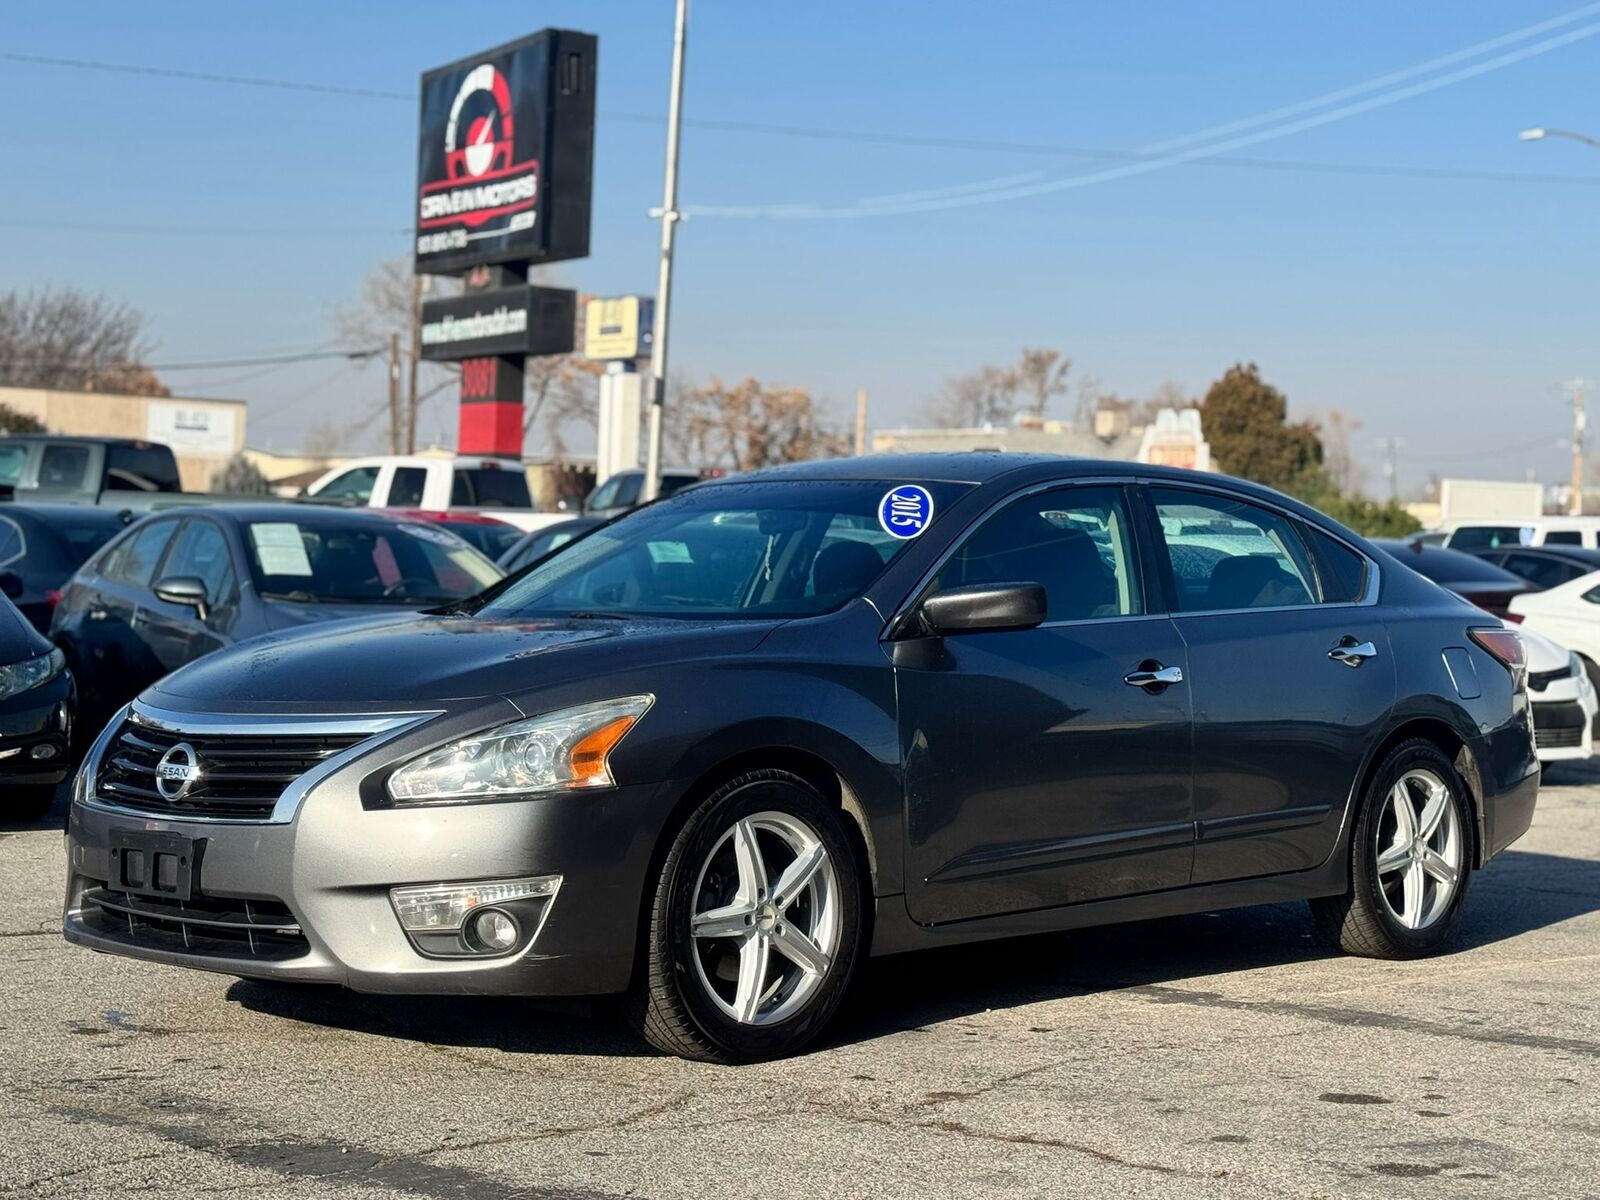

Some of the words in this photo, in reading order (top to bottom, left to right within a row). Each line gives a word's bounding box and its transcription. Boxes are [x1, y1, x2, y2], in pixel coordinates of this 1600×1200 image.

[420, 187, 475, 219] DRIVEN
[474, 173, 537, 208] MOTORS
[891, 494, 922, 528] 2015
[160, 765, 190, 778] SSAN
